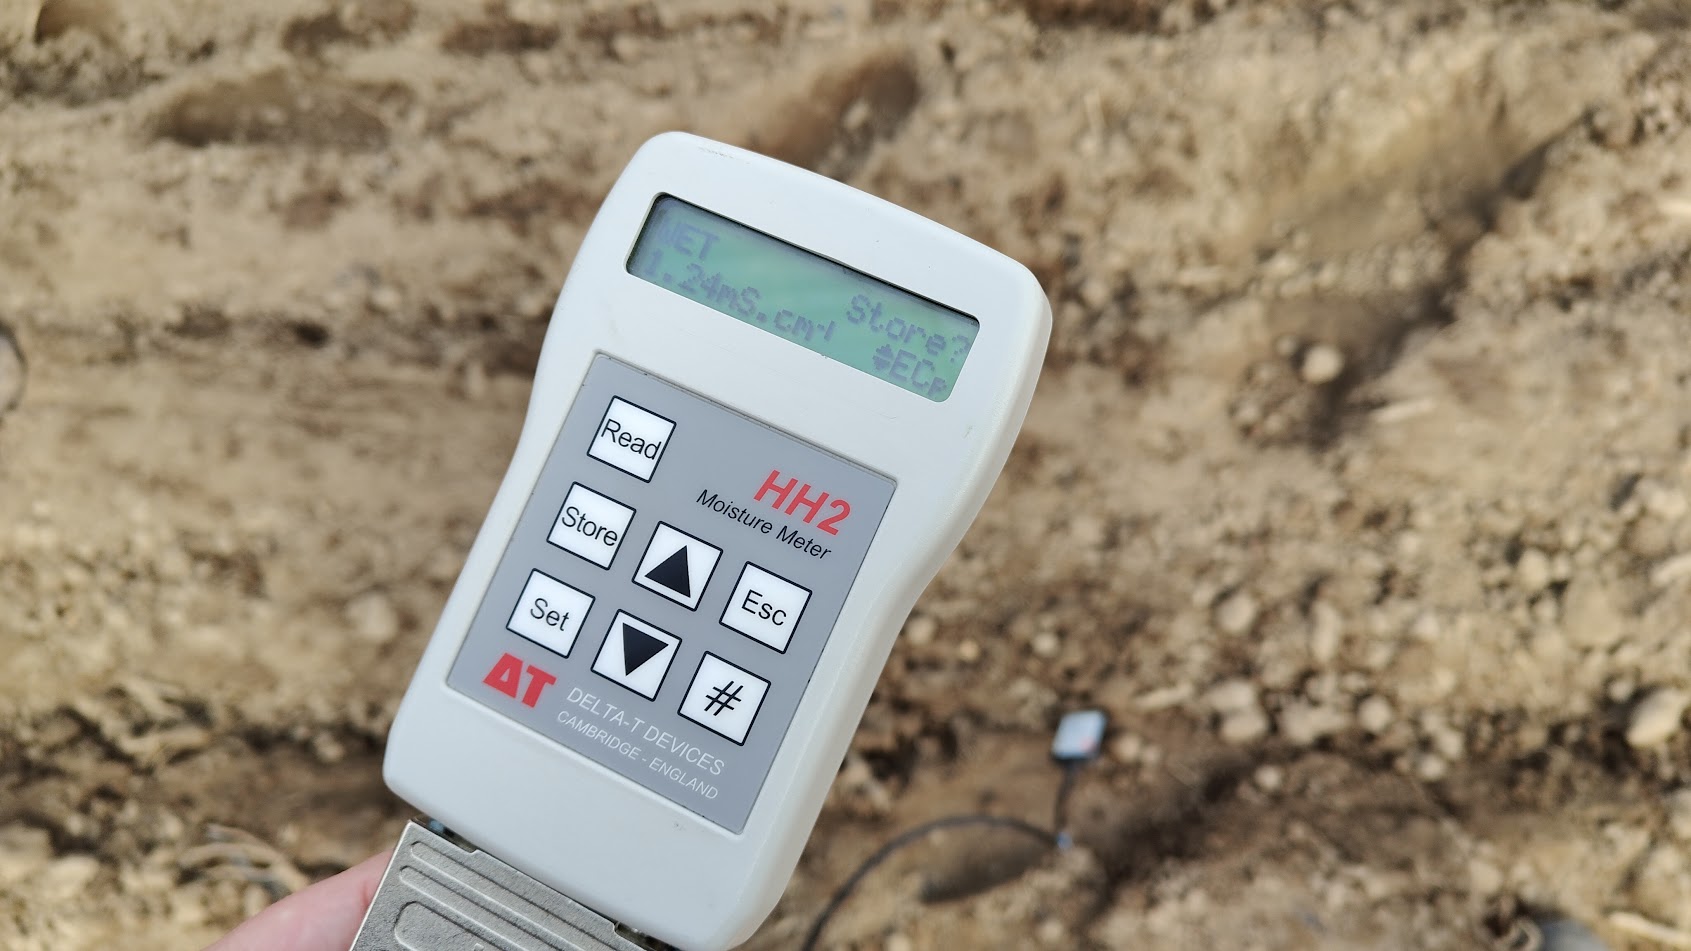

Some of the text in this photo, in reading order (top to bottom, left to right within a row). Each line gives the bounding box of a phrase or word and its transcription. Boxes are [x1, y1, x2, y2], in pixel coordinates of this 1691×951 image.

[846, 294, 971, 364] Store?
[601, 420, 662, 462] Read
[561, 506, 619, 548] Store
[696, 489, 832, 560] Moisture Meter
[753, 469, 852, 536] HH2
[529, 597, 570, 632] Set
[741, 589, 788, 627] Esc
[705, 680, 742, 717] #
[557, 710, 640, 762] CAMBRIDGE
[648, 756, 719, 800] ENGLAND
[567, 687, 725, 776] DELTA-T DEVICES
